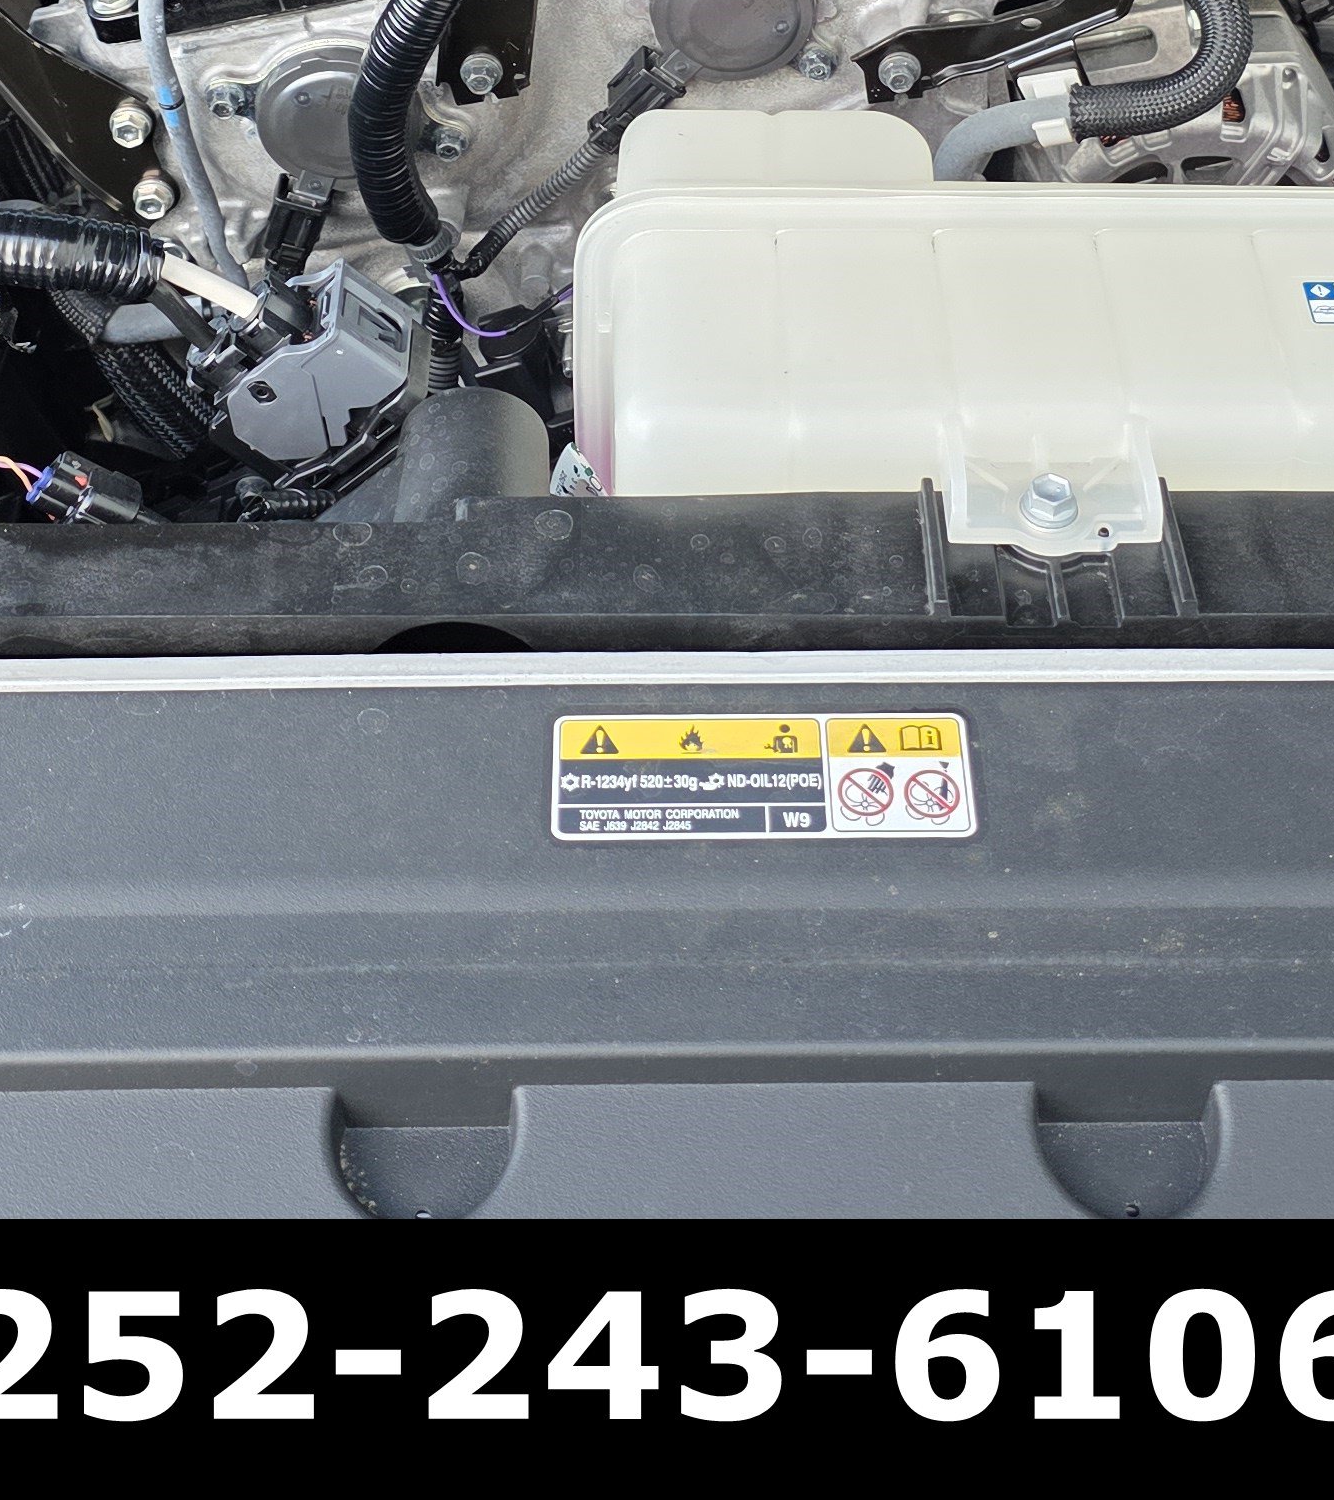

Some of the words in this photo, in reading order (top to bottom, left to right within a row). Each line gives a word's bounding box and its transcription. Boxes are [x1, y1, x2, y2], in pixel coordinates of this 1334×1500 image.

[580, 773, 638, 791] R-1234yf
[640, 773, 699, 792] 520±30g
[726, 772, 823, 791] ND-OIL12(POE)
[579, 809, 622, 819] TOYOTA
[624, 809, 662, 819] MOTOR
[664, 808, 740, 819] CORPORATION
[783, 812, 810, 828] W9
[579, 820, 601, 831] SAE
[603, 820, 627, 831] J639
[630, 820, 660, 831] J2842
[662, 820, 692, 831] J2845
